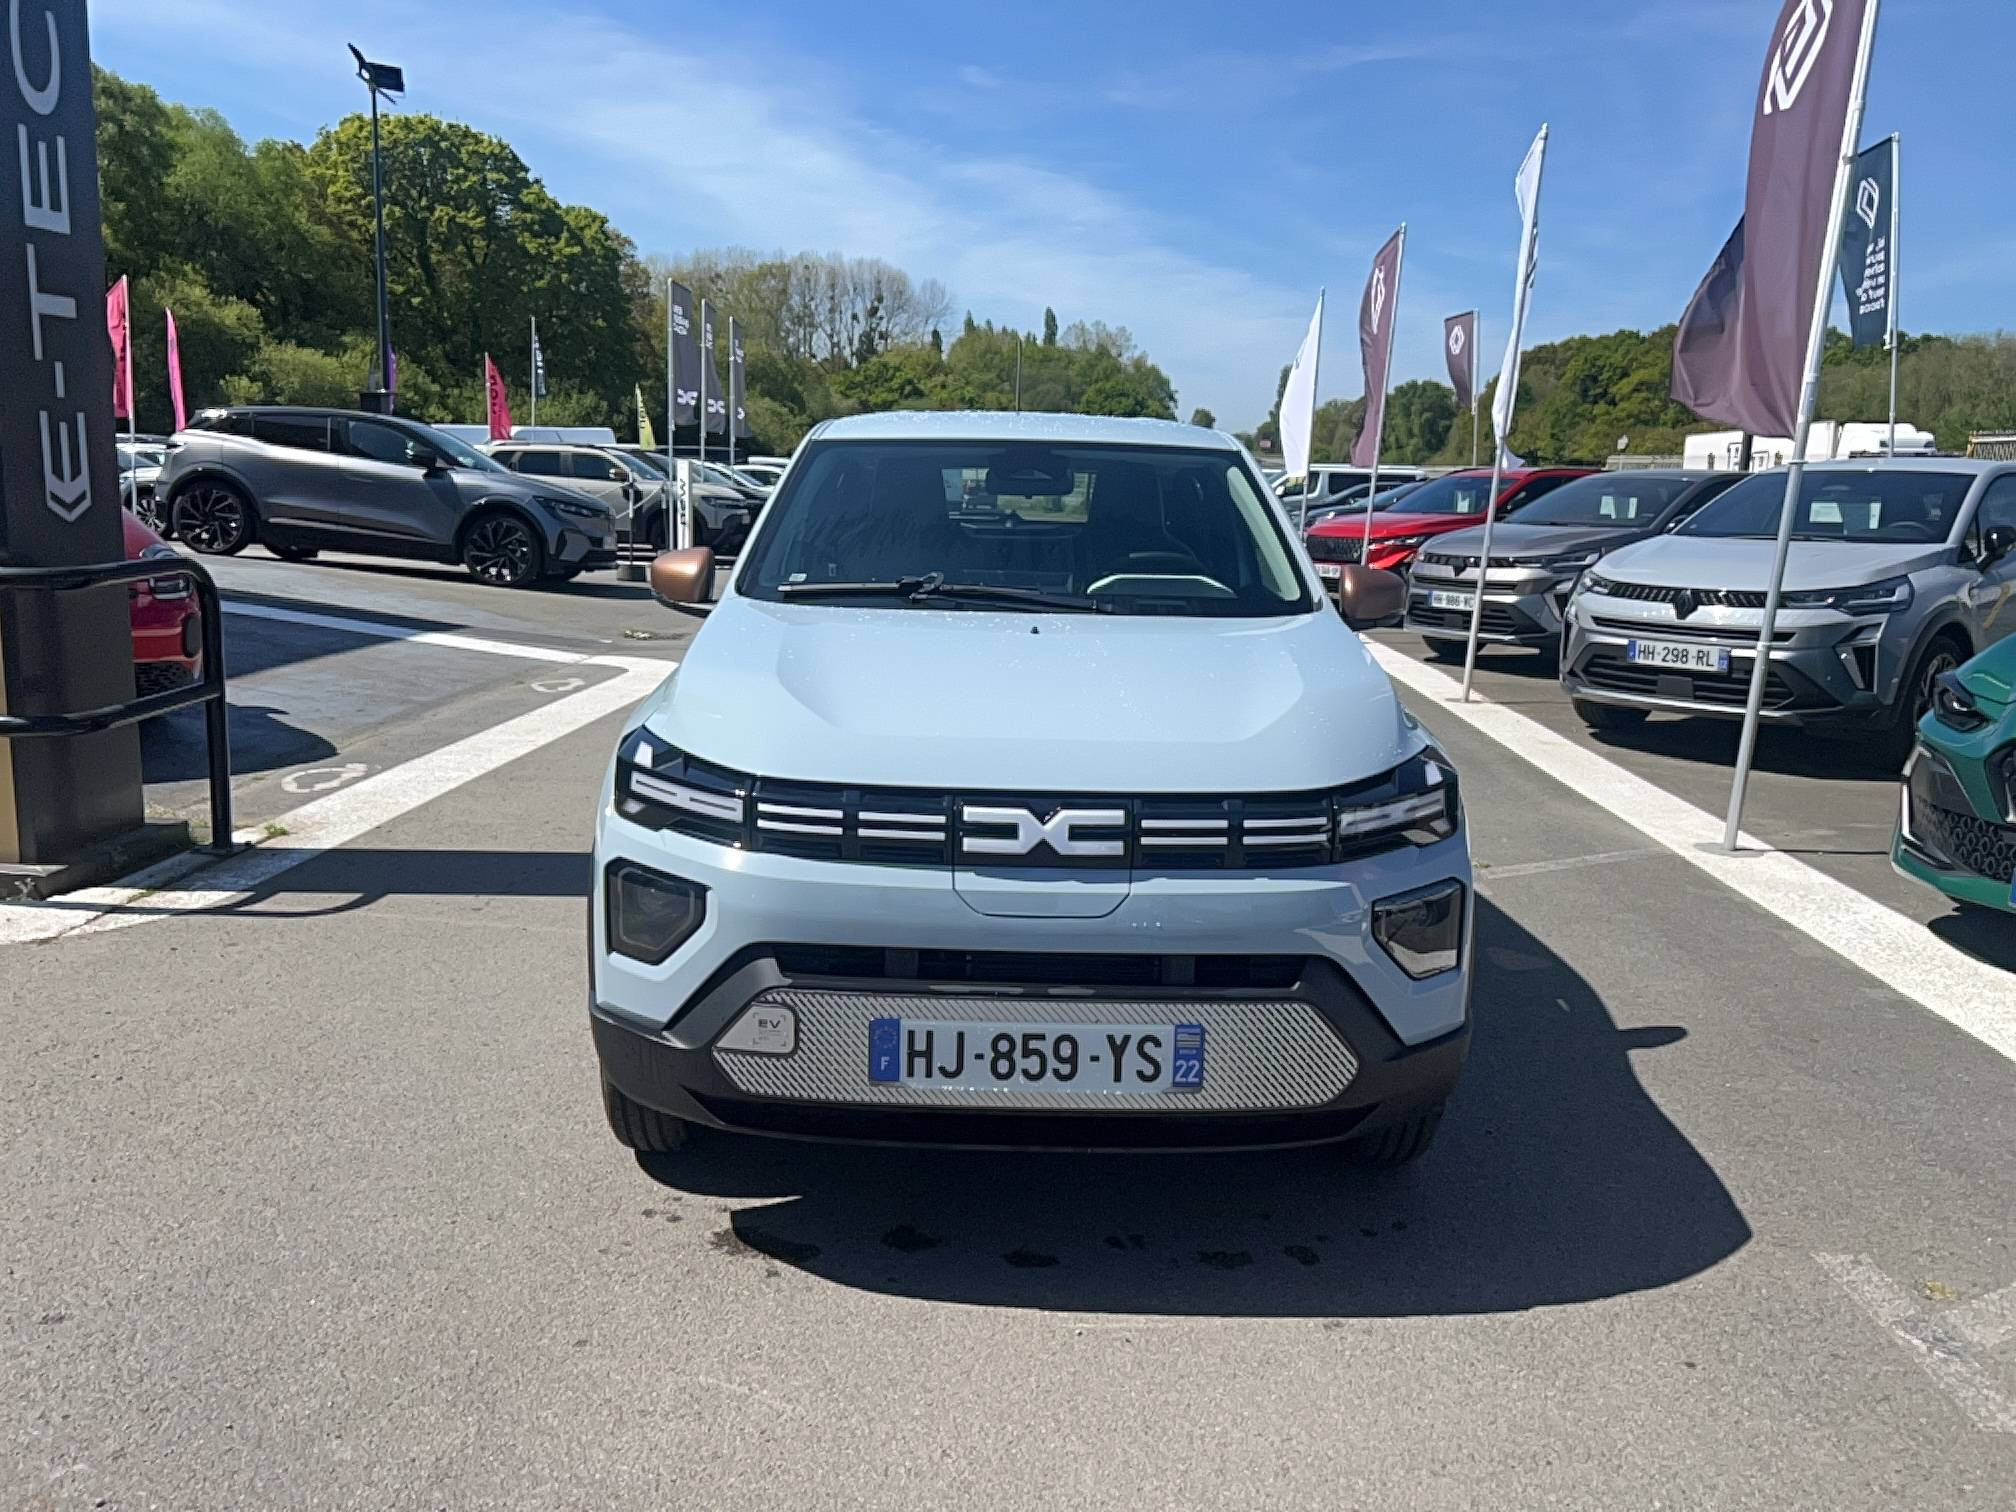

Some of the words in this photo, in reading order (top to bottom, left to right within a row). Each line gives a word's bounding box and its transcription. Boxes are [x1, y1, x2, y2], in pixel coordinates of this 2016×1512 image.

[1637, 644, 1715, 667] HH-298-RL
[880, 1055, 891, 1071] F
[906, 1029, 1163, 1083] HJ-859-YS
[1174, 1060, 1201, 1083] 22
